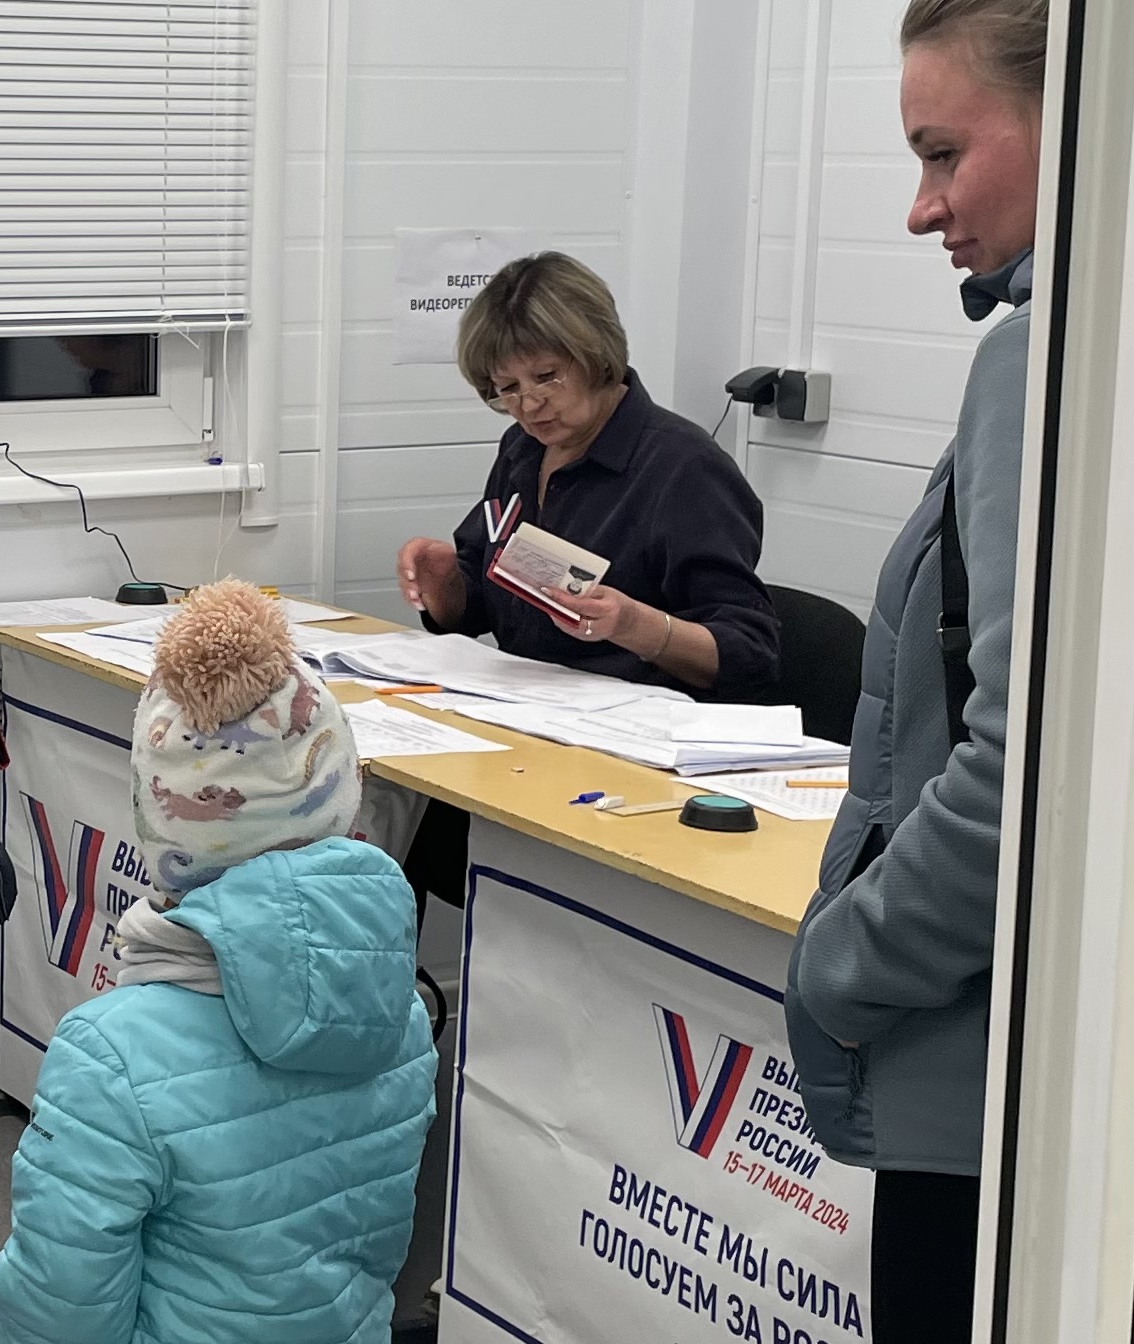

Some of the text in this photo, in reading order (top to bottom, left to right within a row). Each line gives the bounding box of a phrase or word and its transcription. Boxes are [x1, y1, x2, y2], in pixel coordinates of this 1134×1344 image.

[410, 298, 473, 312] ВИДЕОРЕГ
[447, 274, 496, 288] ВЕДЕТС
[735, 1119, 821, 1179] РОССИИ
[763, 1171, 814, 1214] МАРТА
[811, 1199, 849, 1235] 2024
[580, 1209, 717, 1323] ГОЛОСУЕМ
[608, 1164, 864, 1338] ВМЕСТЕ МЫ СИЛА
